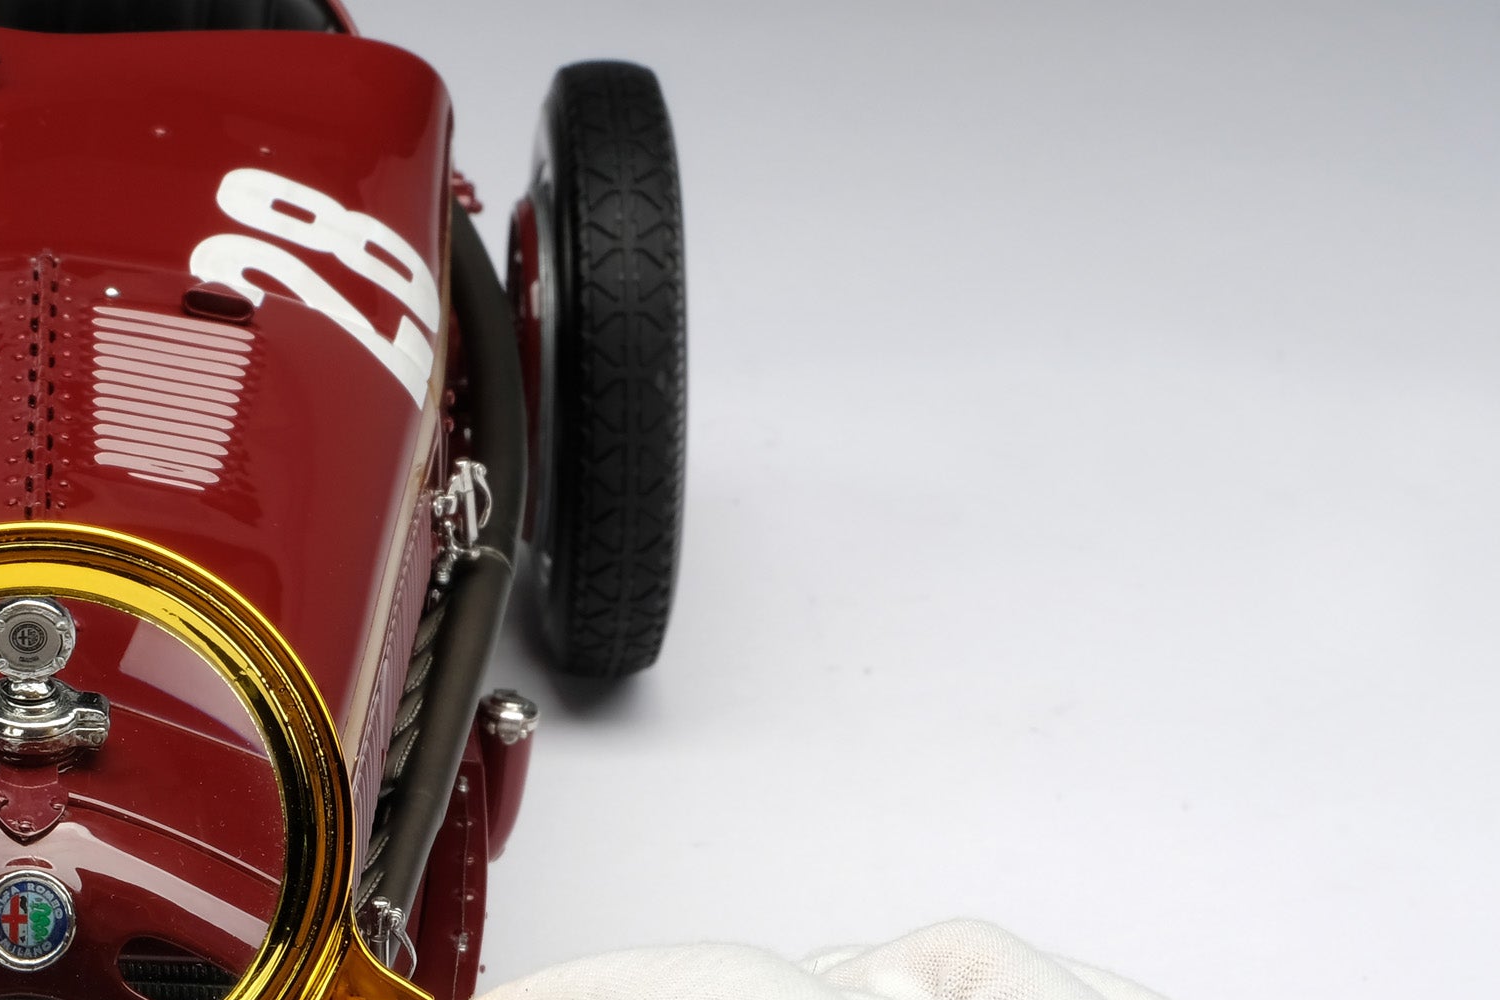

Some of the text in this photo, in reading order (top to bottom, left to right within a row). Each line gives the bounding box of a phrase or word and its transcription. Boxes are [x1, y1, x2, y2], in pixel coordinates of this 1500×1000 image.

[188, 167, 440, 412] 28
[27, 882, 63, 919] ROMEO
[0, 938, 52, 957] MILANO
